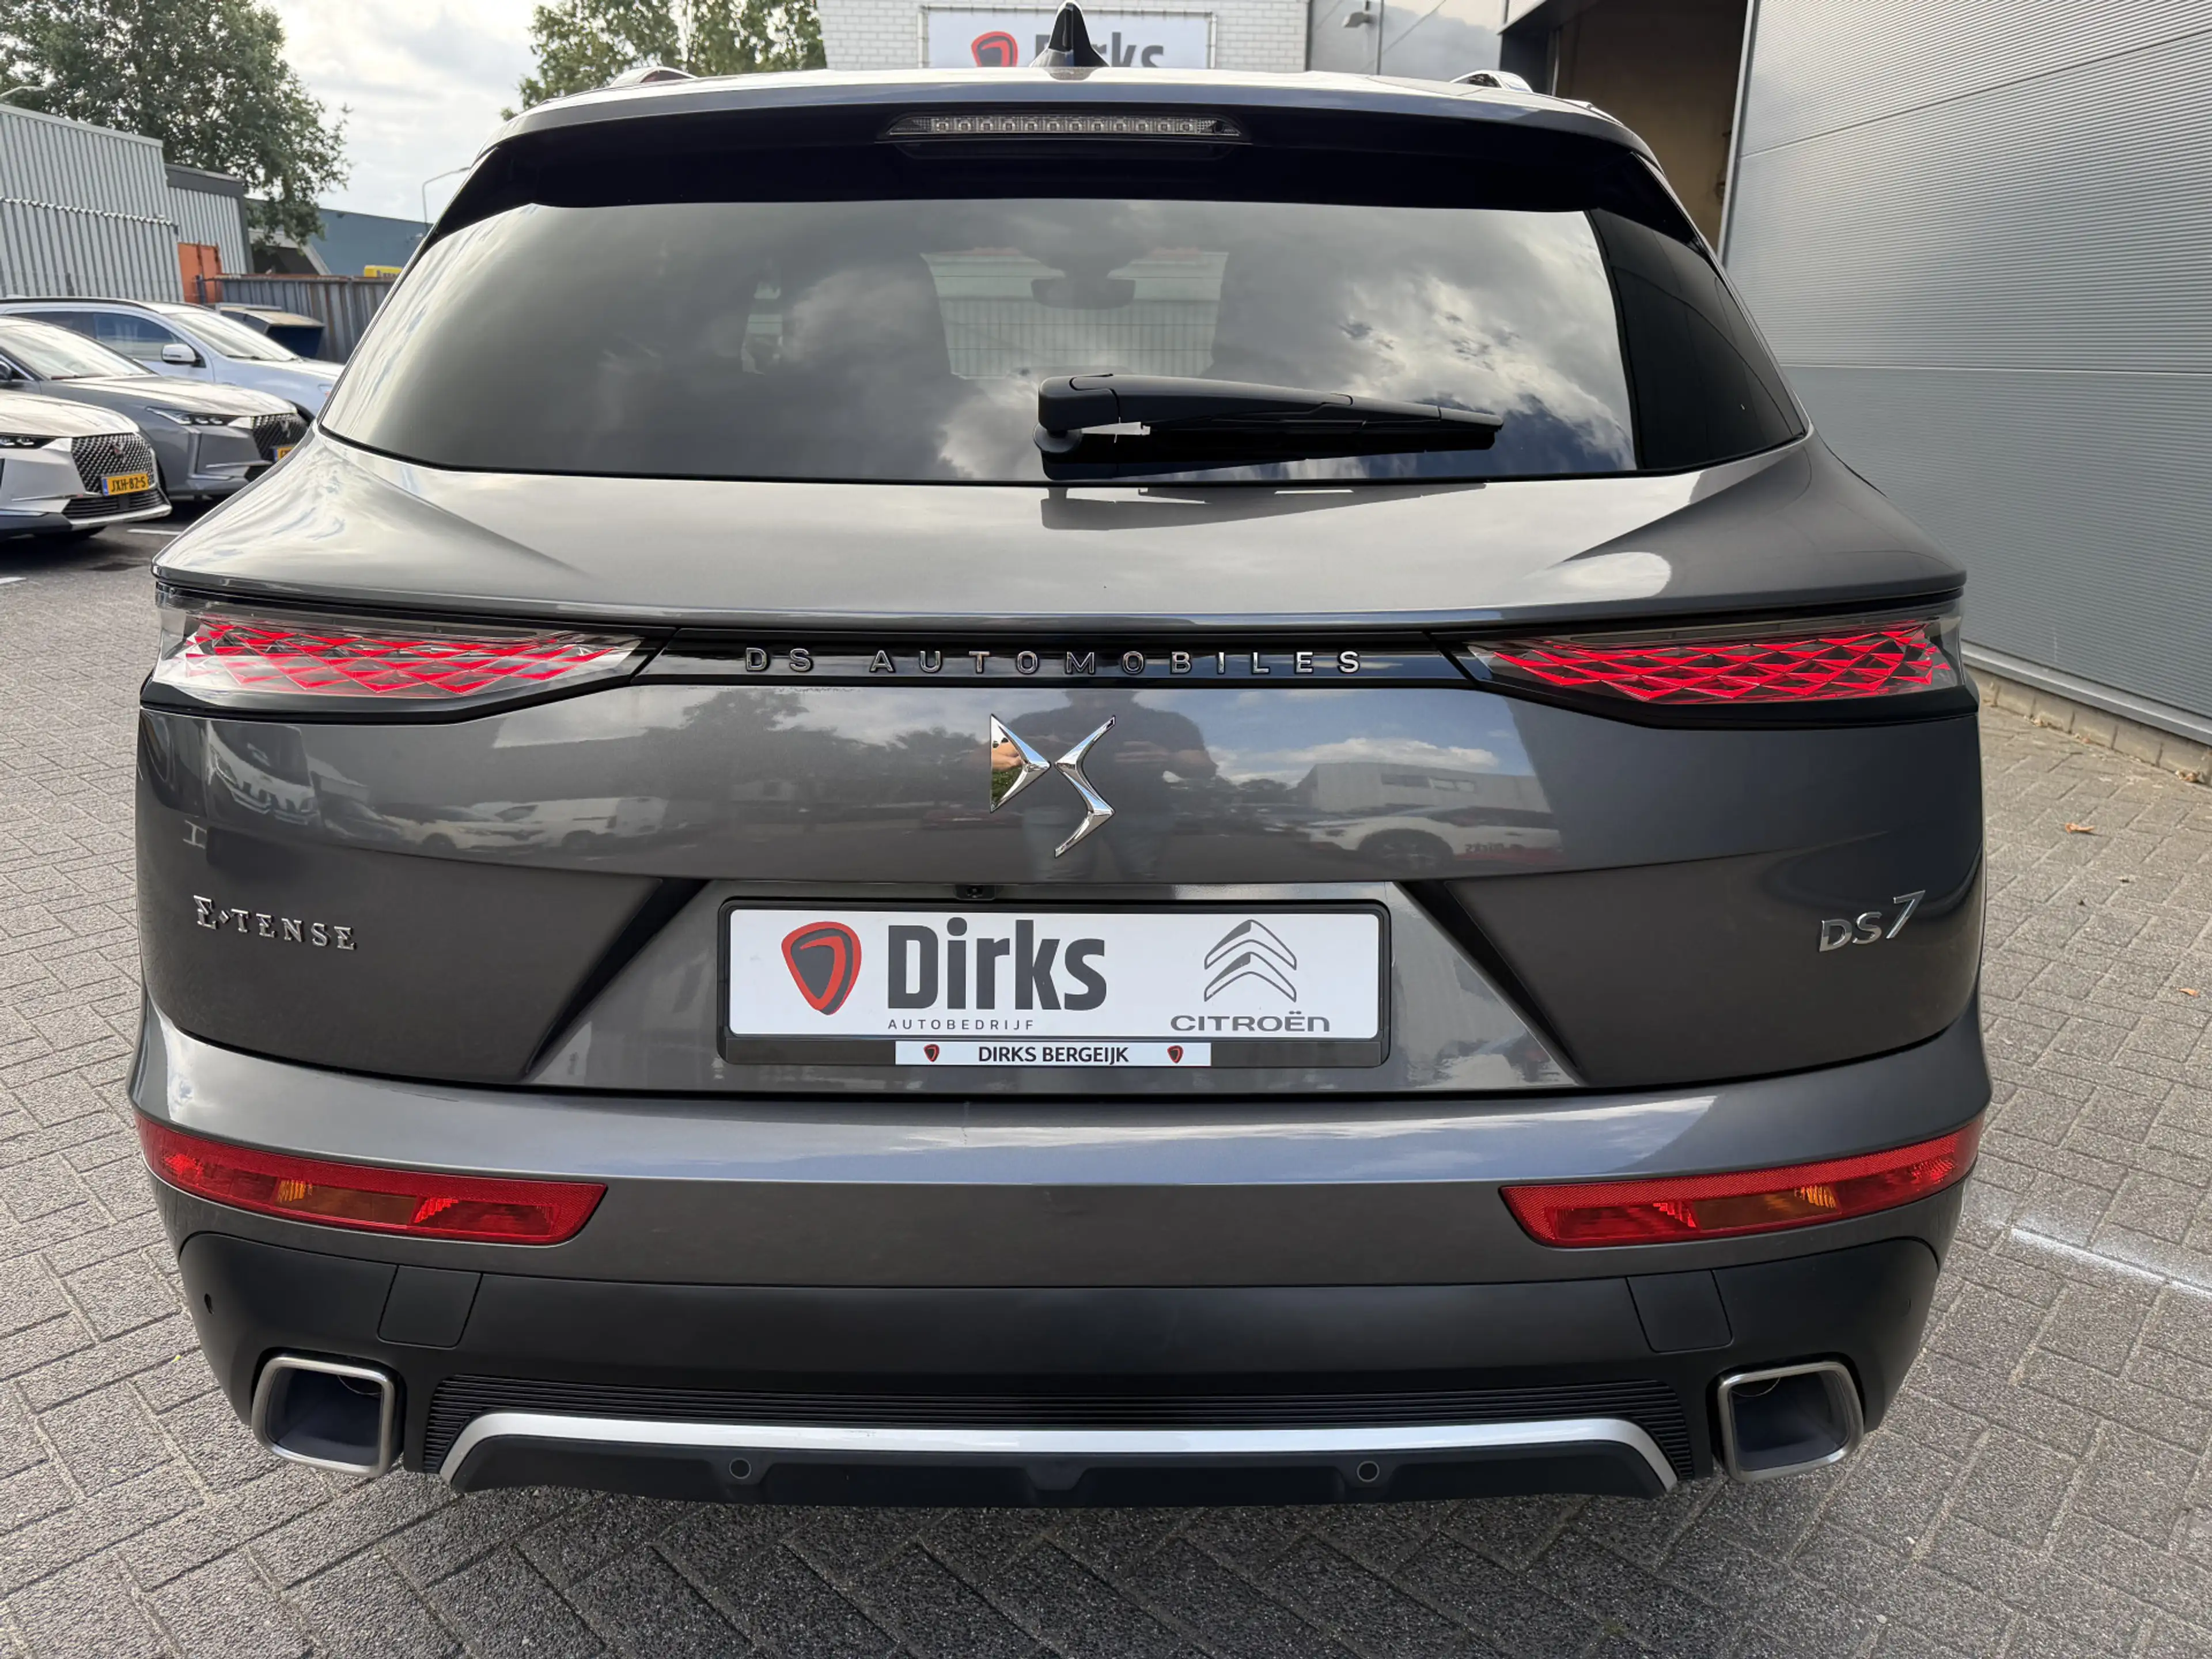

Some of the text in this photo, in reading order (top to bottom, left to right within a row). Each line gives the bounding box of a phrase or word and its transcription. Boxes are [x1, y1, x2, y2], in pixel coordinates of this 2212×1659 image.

[112, 476, 146, 492] JXH-82-S
[745, 647, 1360, 675] DS AUTOMOBILES
[888, 917, 1107, 1011] Dirks
[888, 1018, 1034, 1031] AUTOBEDRIJF
[979, 1046, 1129, 1065] DIRKS BERGEIJK
